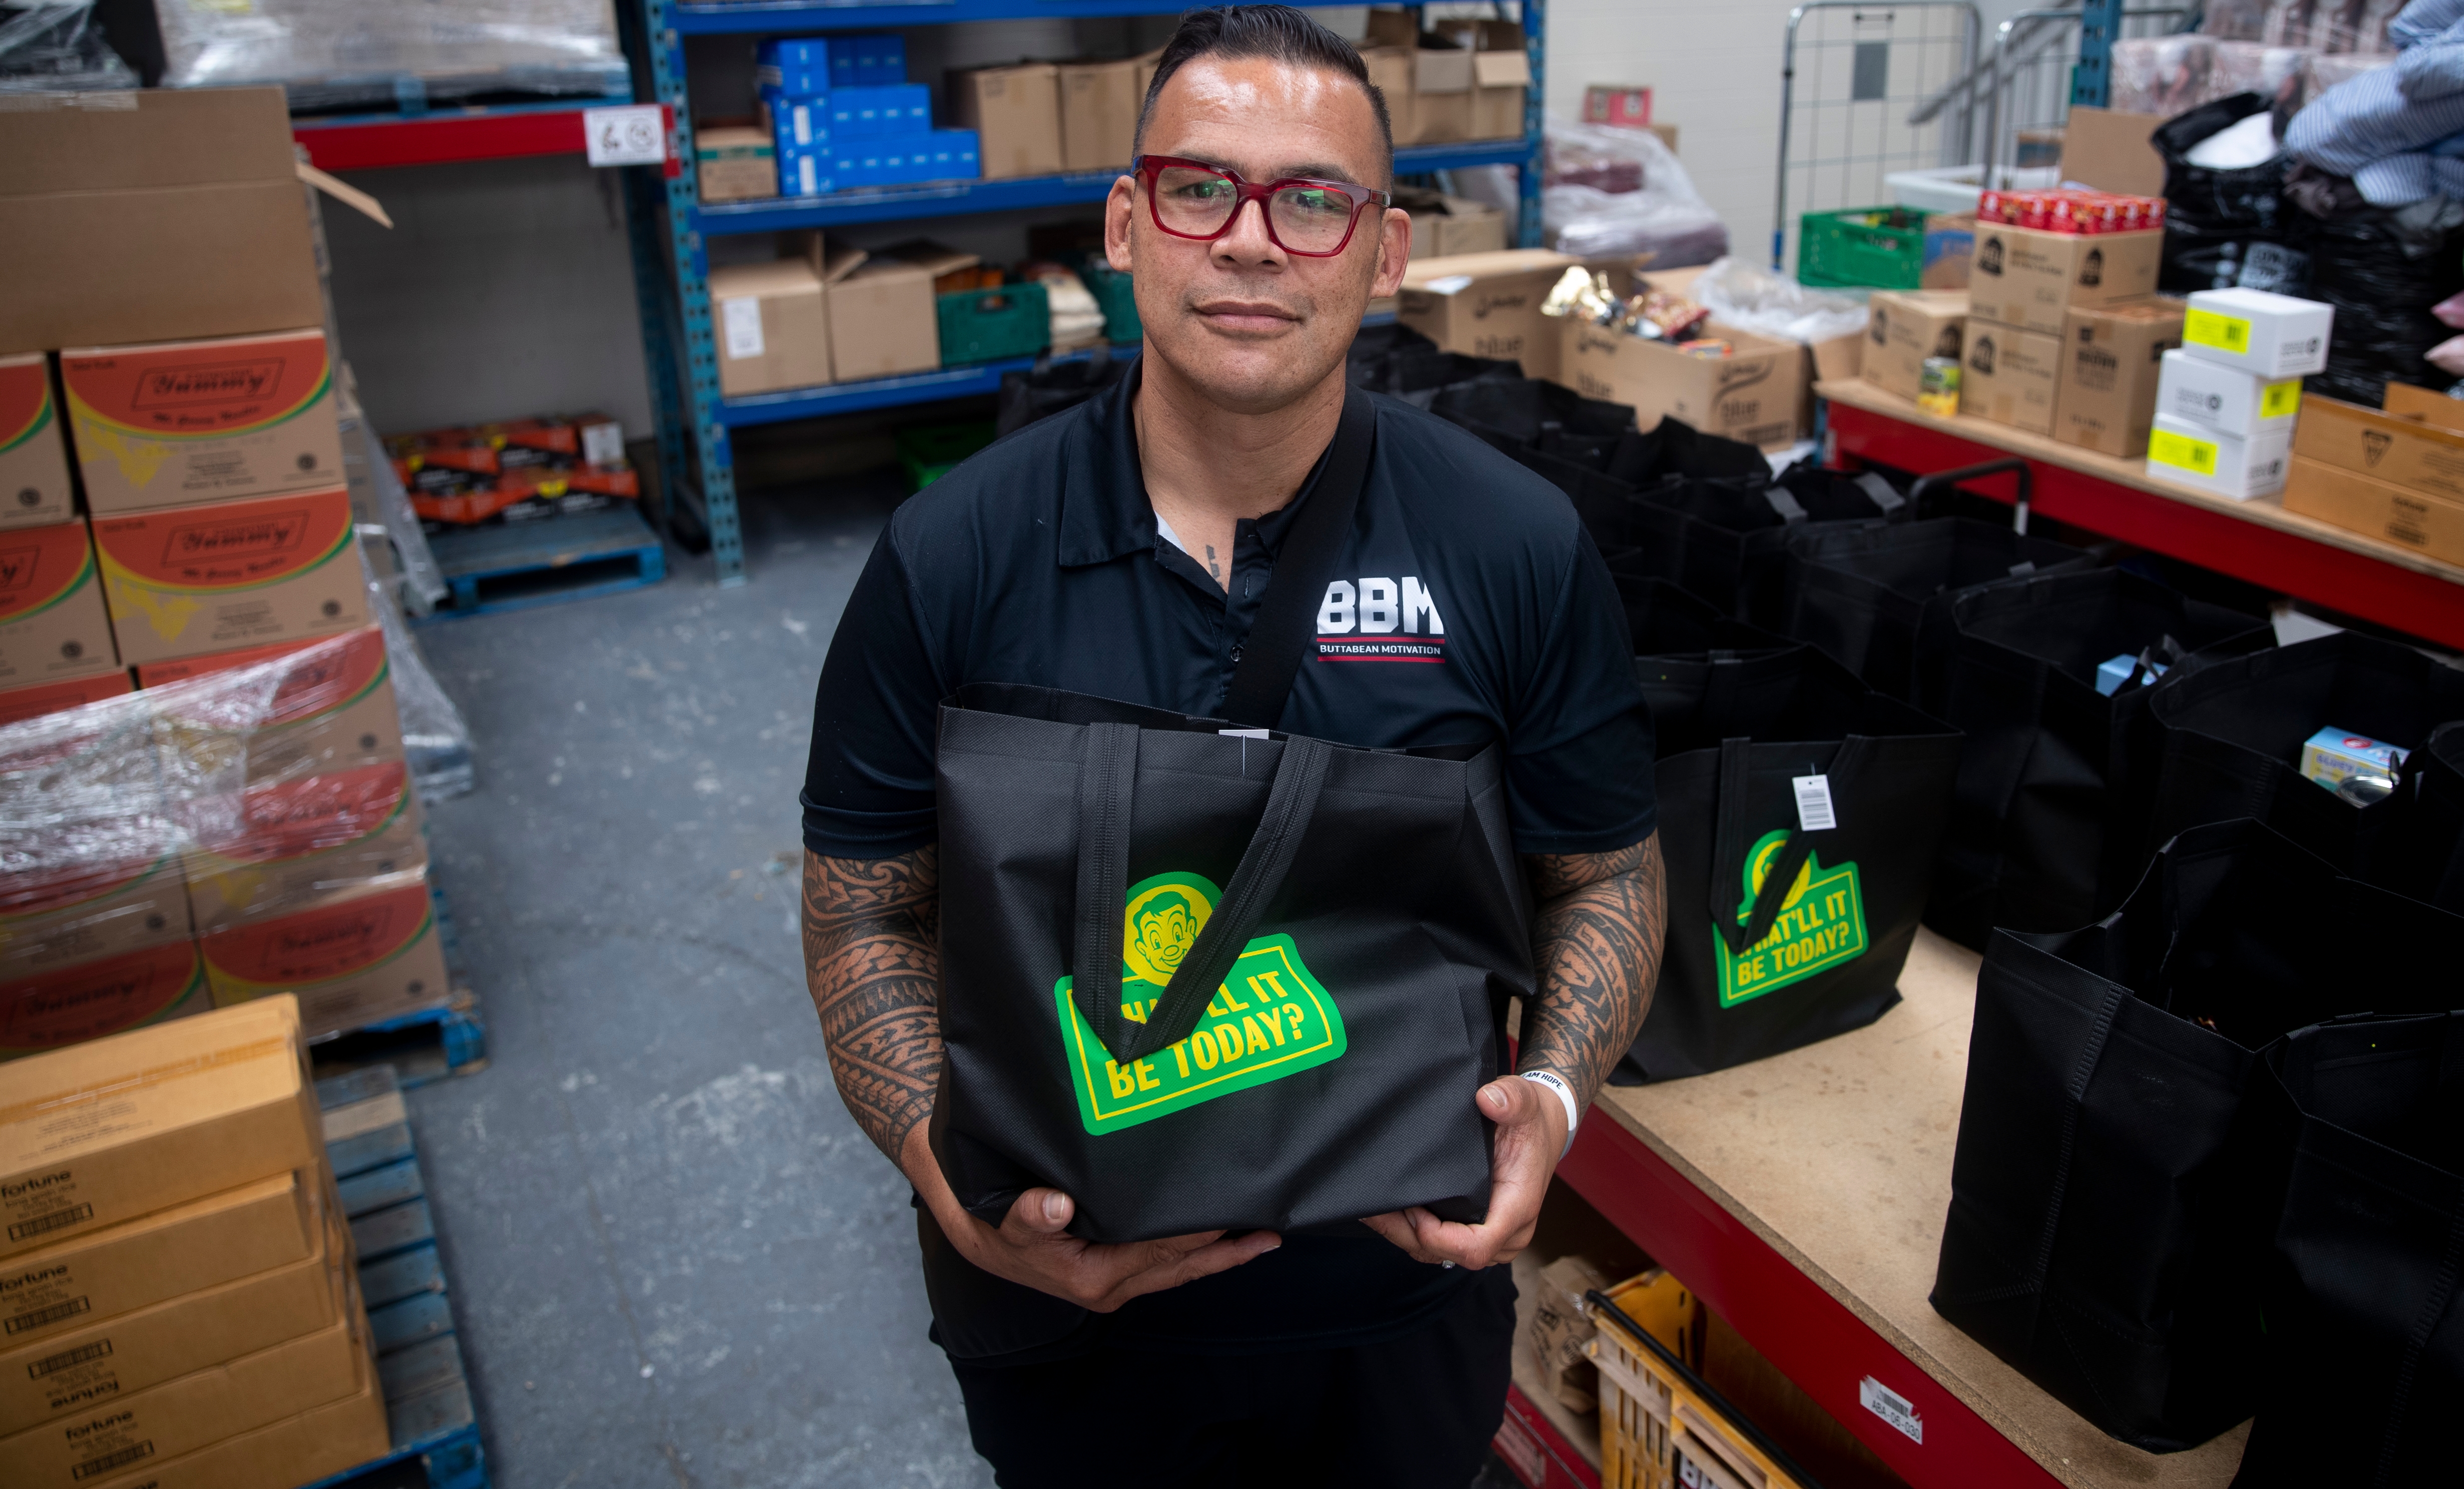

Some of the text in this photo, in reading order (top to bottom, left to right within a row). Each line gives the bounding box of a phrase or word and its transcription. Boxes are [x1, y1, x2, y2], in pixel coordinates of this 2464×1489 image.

[1317, 576, 1444, 634] BBM
[1320, 645, 1441, 655] BUTTABEAN MOTIVATION
[1825, 890, 1847, 921] IT
[1738, 921, 1850, 986] BE TODAY?
[1247, 970, 1288, 1004] IT
[1105, 1055, 1160, 1099] BE
[1165, 1003, 1305, 1079] TODAY?
[1541, 1074, 1563, 1090] HOPE
[2, 1170, 71, 1198] fortune
[51, 1379, 119, 1409] fortune
[66, 1410, 133, 1440] fortune
